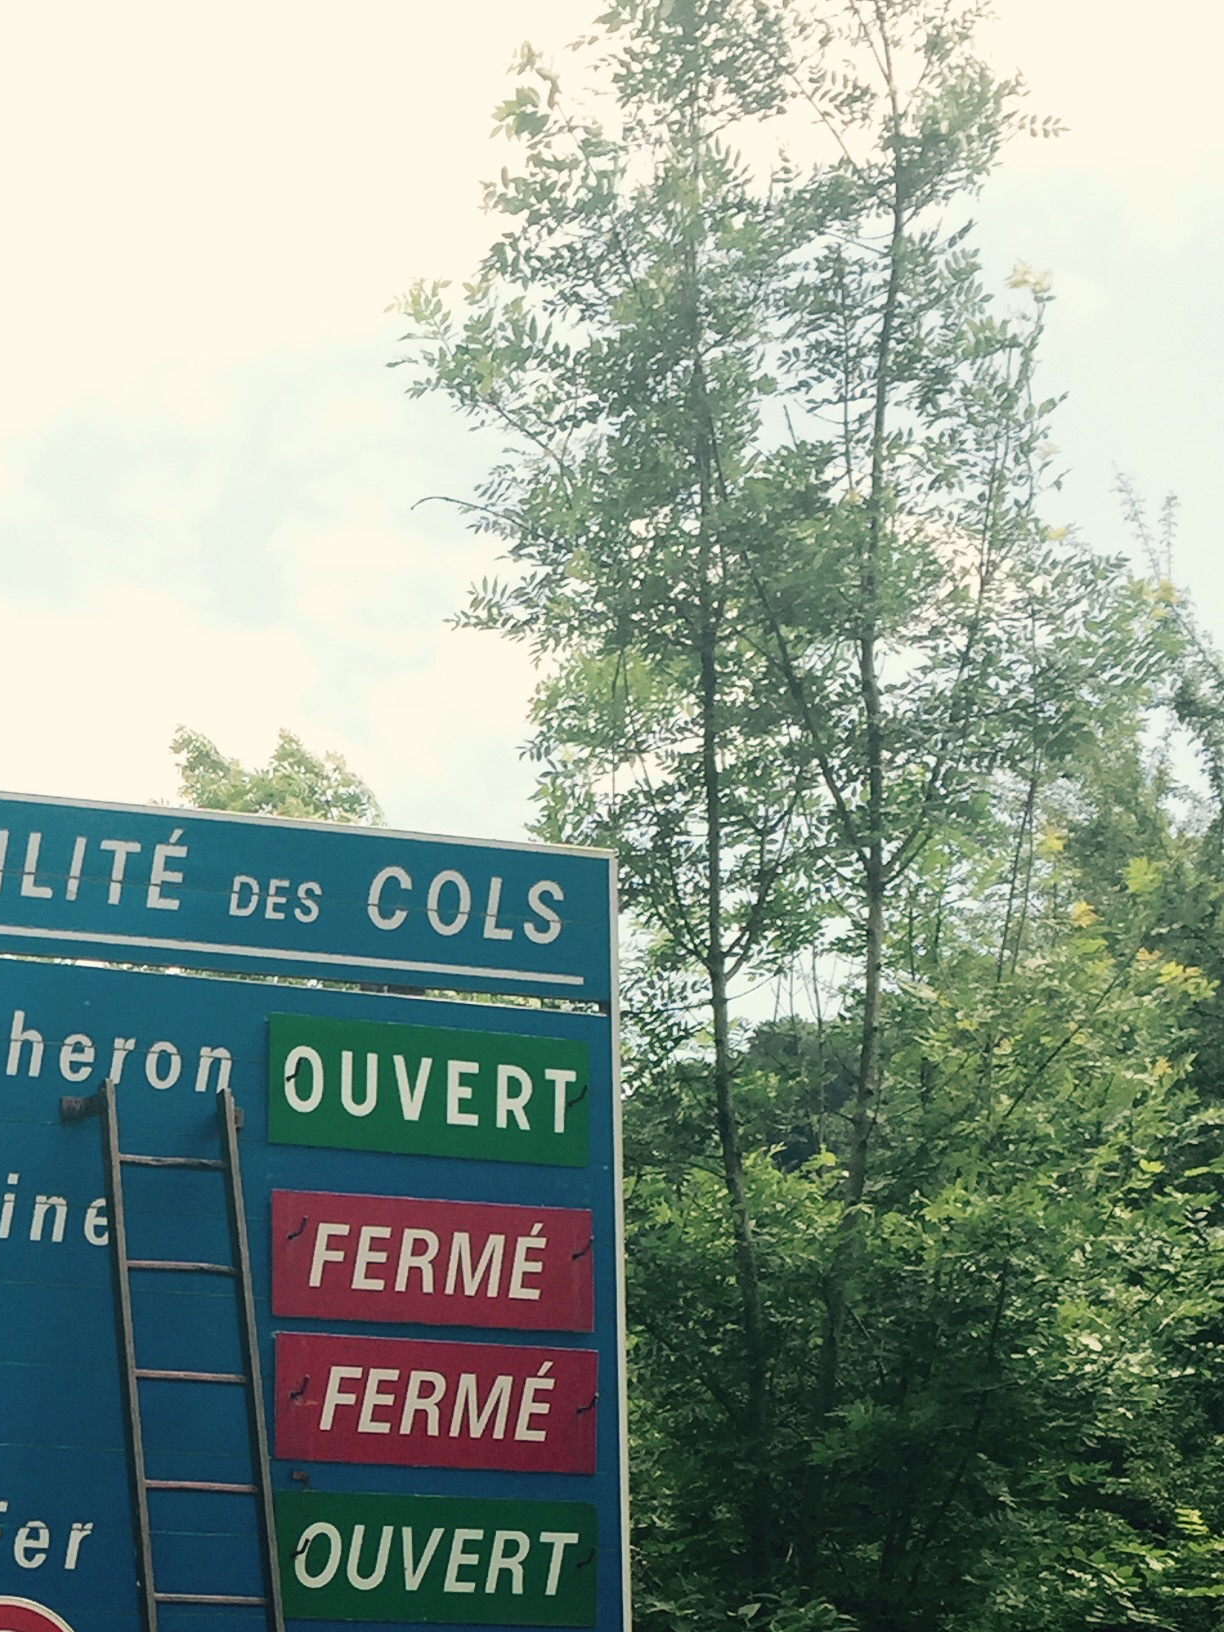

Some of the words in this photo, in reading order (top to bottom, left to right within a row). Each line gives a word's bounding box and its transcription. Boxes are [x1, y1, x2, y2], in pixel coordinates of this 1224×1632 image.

[230, 876, 321, 922] DES
[368, 867, 563, 943] COLS
[285, 1046, 576, 1132] OUVERT
[309, 1223, 546, 1299] FERMÉ
[320, 1362, 554, 1441] FERMÉ
[296, 1523, 578, 1594] OUVERT
